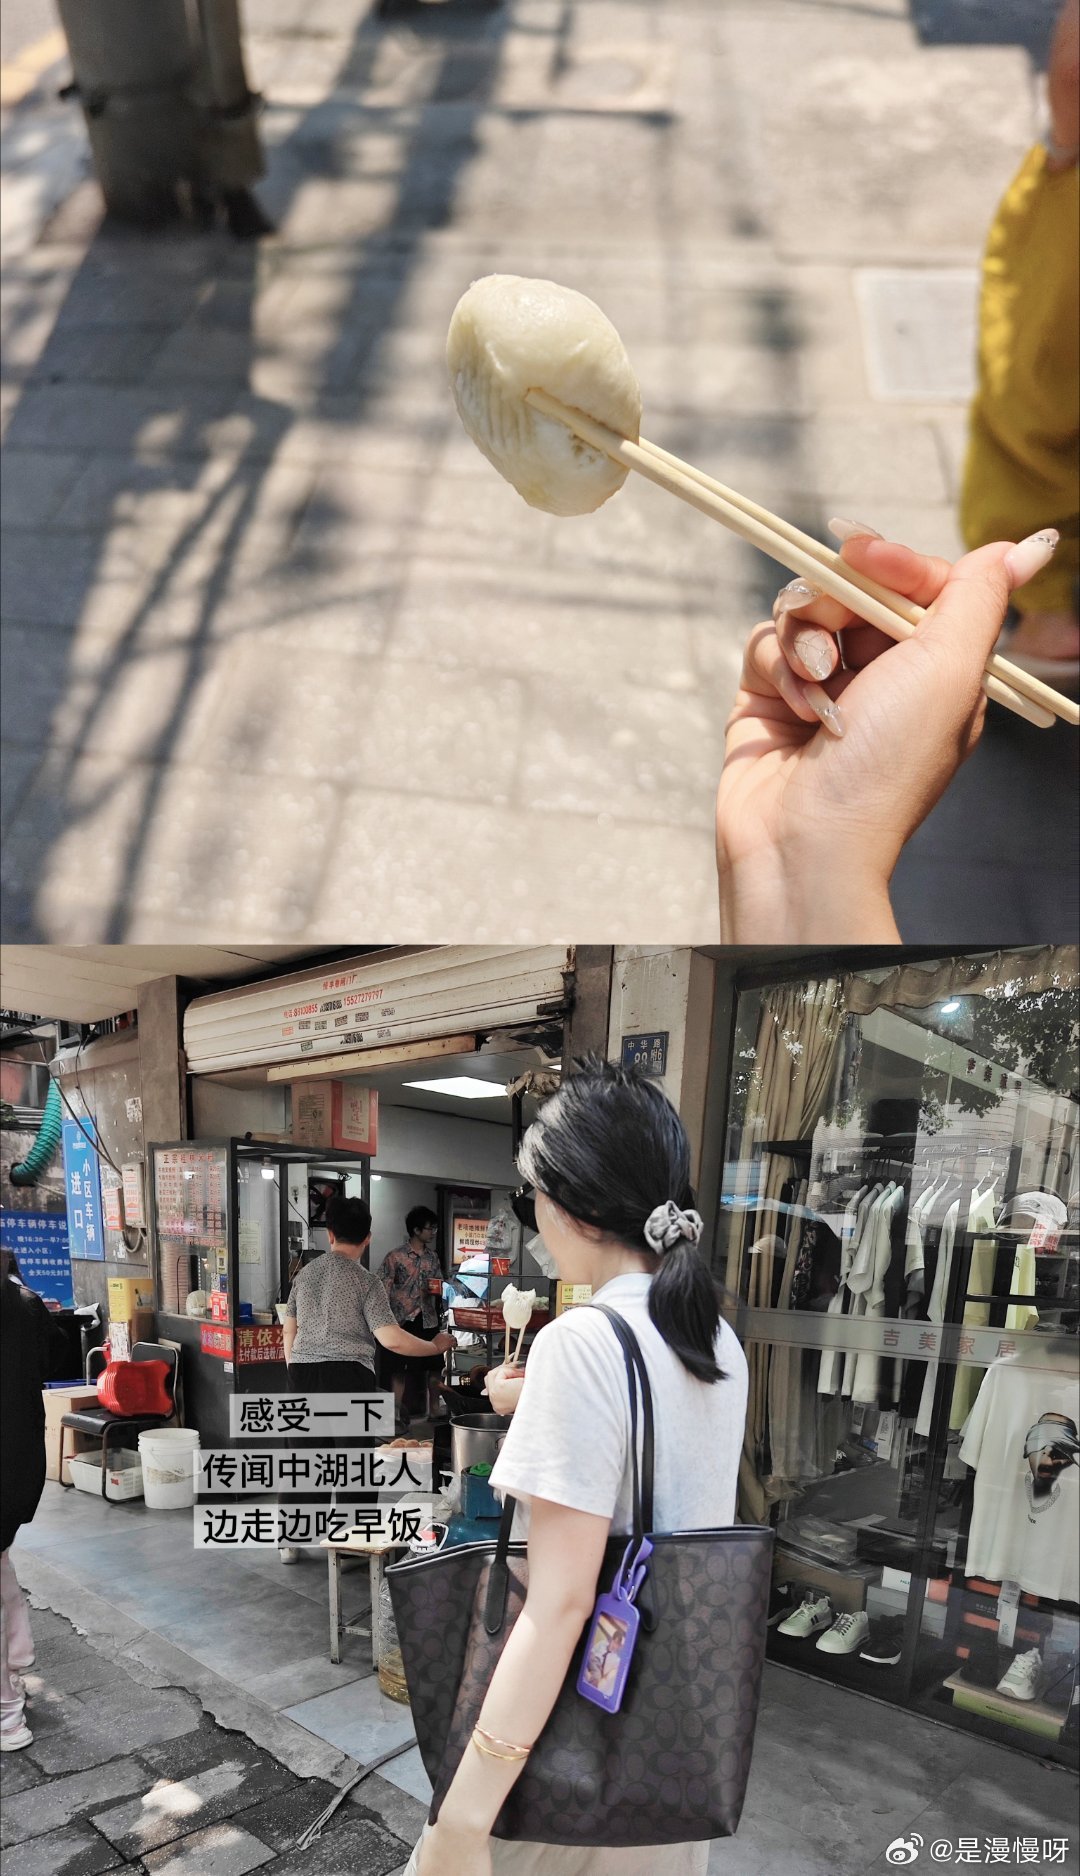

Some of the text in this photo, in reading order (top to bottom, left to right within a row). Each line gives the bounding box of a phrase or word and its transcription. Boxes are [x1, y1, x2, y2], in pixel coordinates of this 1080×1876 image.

[627, 1038, 661, 1051] 中华路
[70, 1171, 84, 1230] 进口
[82, 1158, 96, 1242] 小区车辆
[882, 1328, 1017, 1358] 吉美家居
